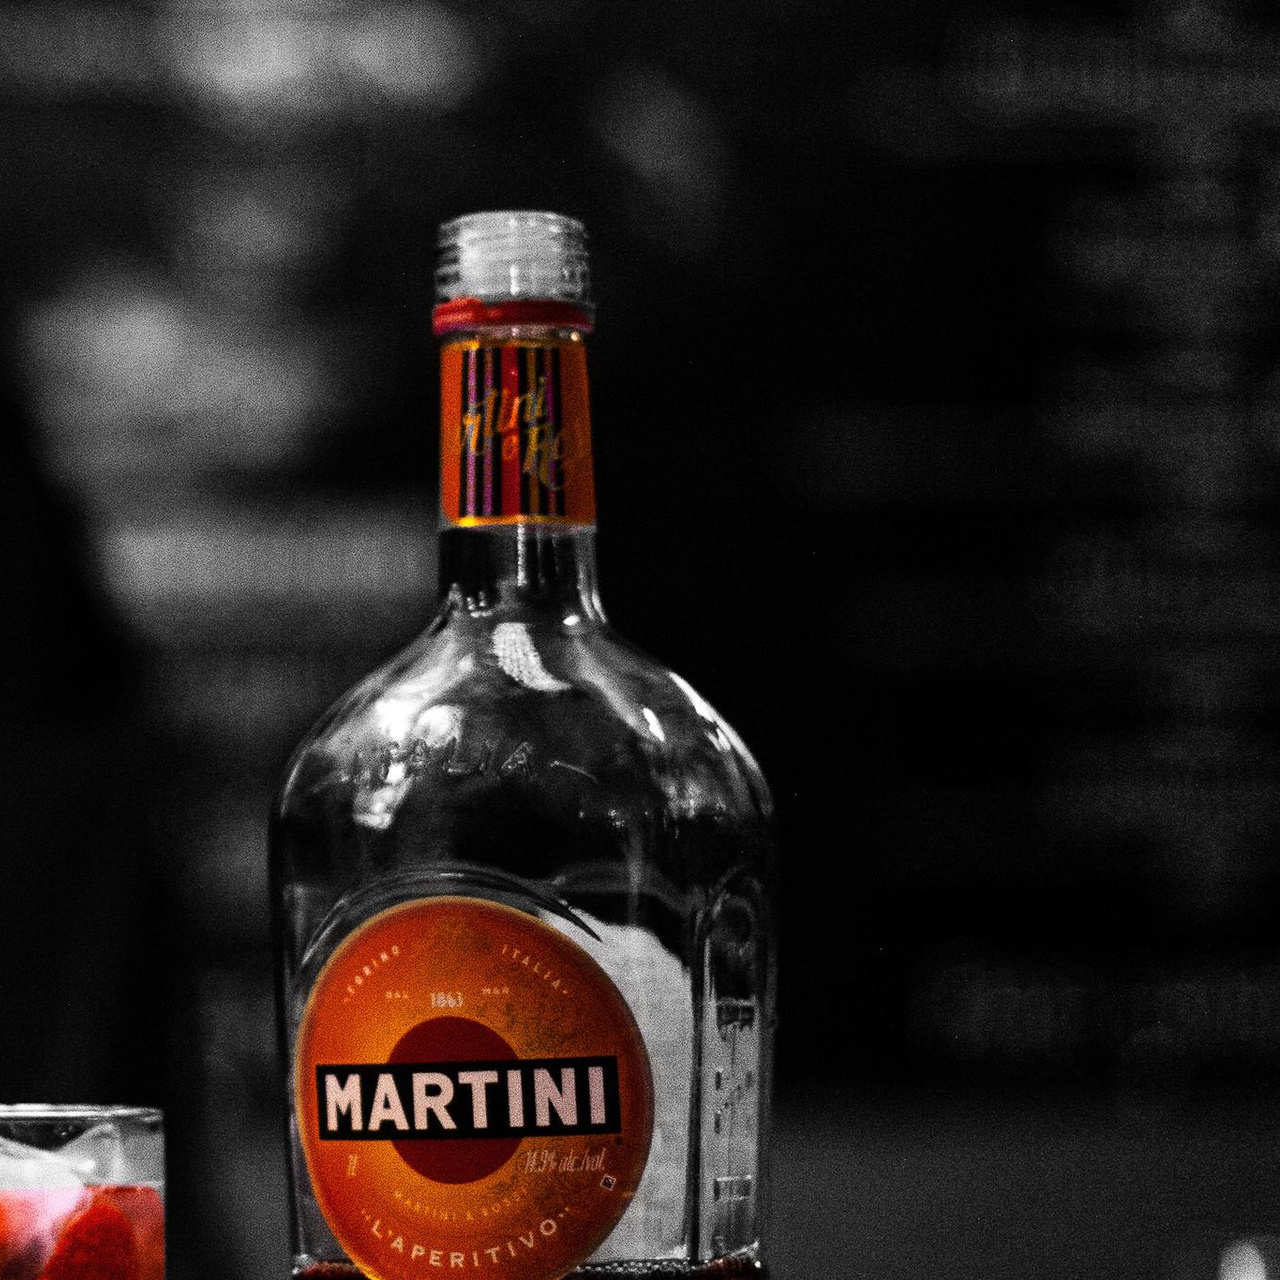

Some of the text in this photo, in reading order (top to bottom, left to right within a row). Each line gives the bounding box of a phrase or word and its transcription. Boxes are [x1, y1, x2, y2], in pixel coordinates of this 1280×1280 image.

[346, 944, 400, 996] TORINO
[501, 944, 562, 990] ITALIA
[429, 991, 465, 1009] 1863
[325, 1067, 606, 1132] MARTINI
[393, 1189, 458, 1222] MARTINI
[370, 1217, 559, 1268] L'APERITIVO
